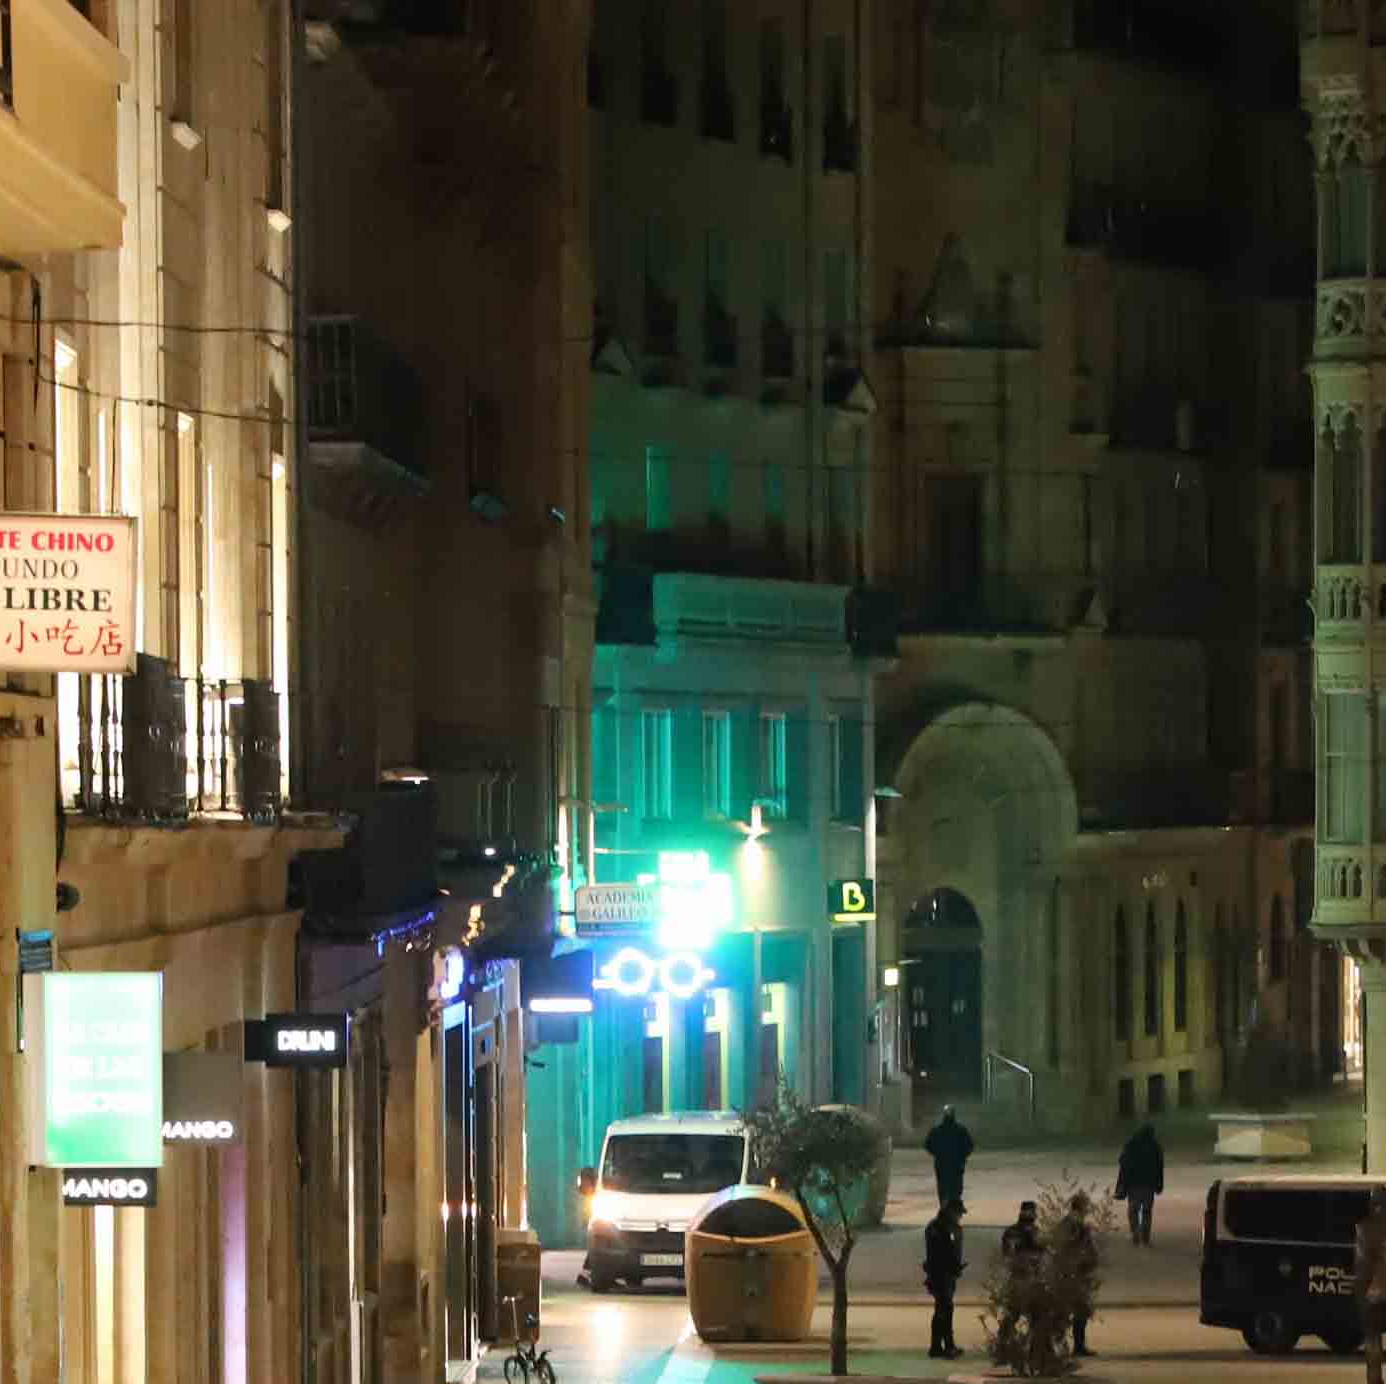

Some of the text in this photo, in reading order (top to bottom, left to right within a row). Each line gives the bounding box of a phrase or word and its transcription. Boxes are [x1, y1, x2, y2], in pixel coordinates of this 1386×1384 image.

[31, 531, 114, 553] CHINO
[4, 586, 112, 612] LIBRE
[842, 881, 866, 912] B
[1309, 1265, 1358, 1280] POL
[1309, 1281, 1354, 1296] NAC
